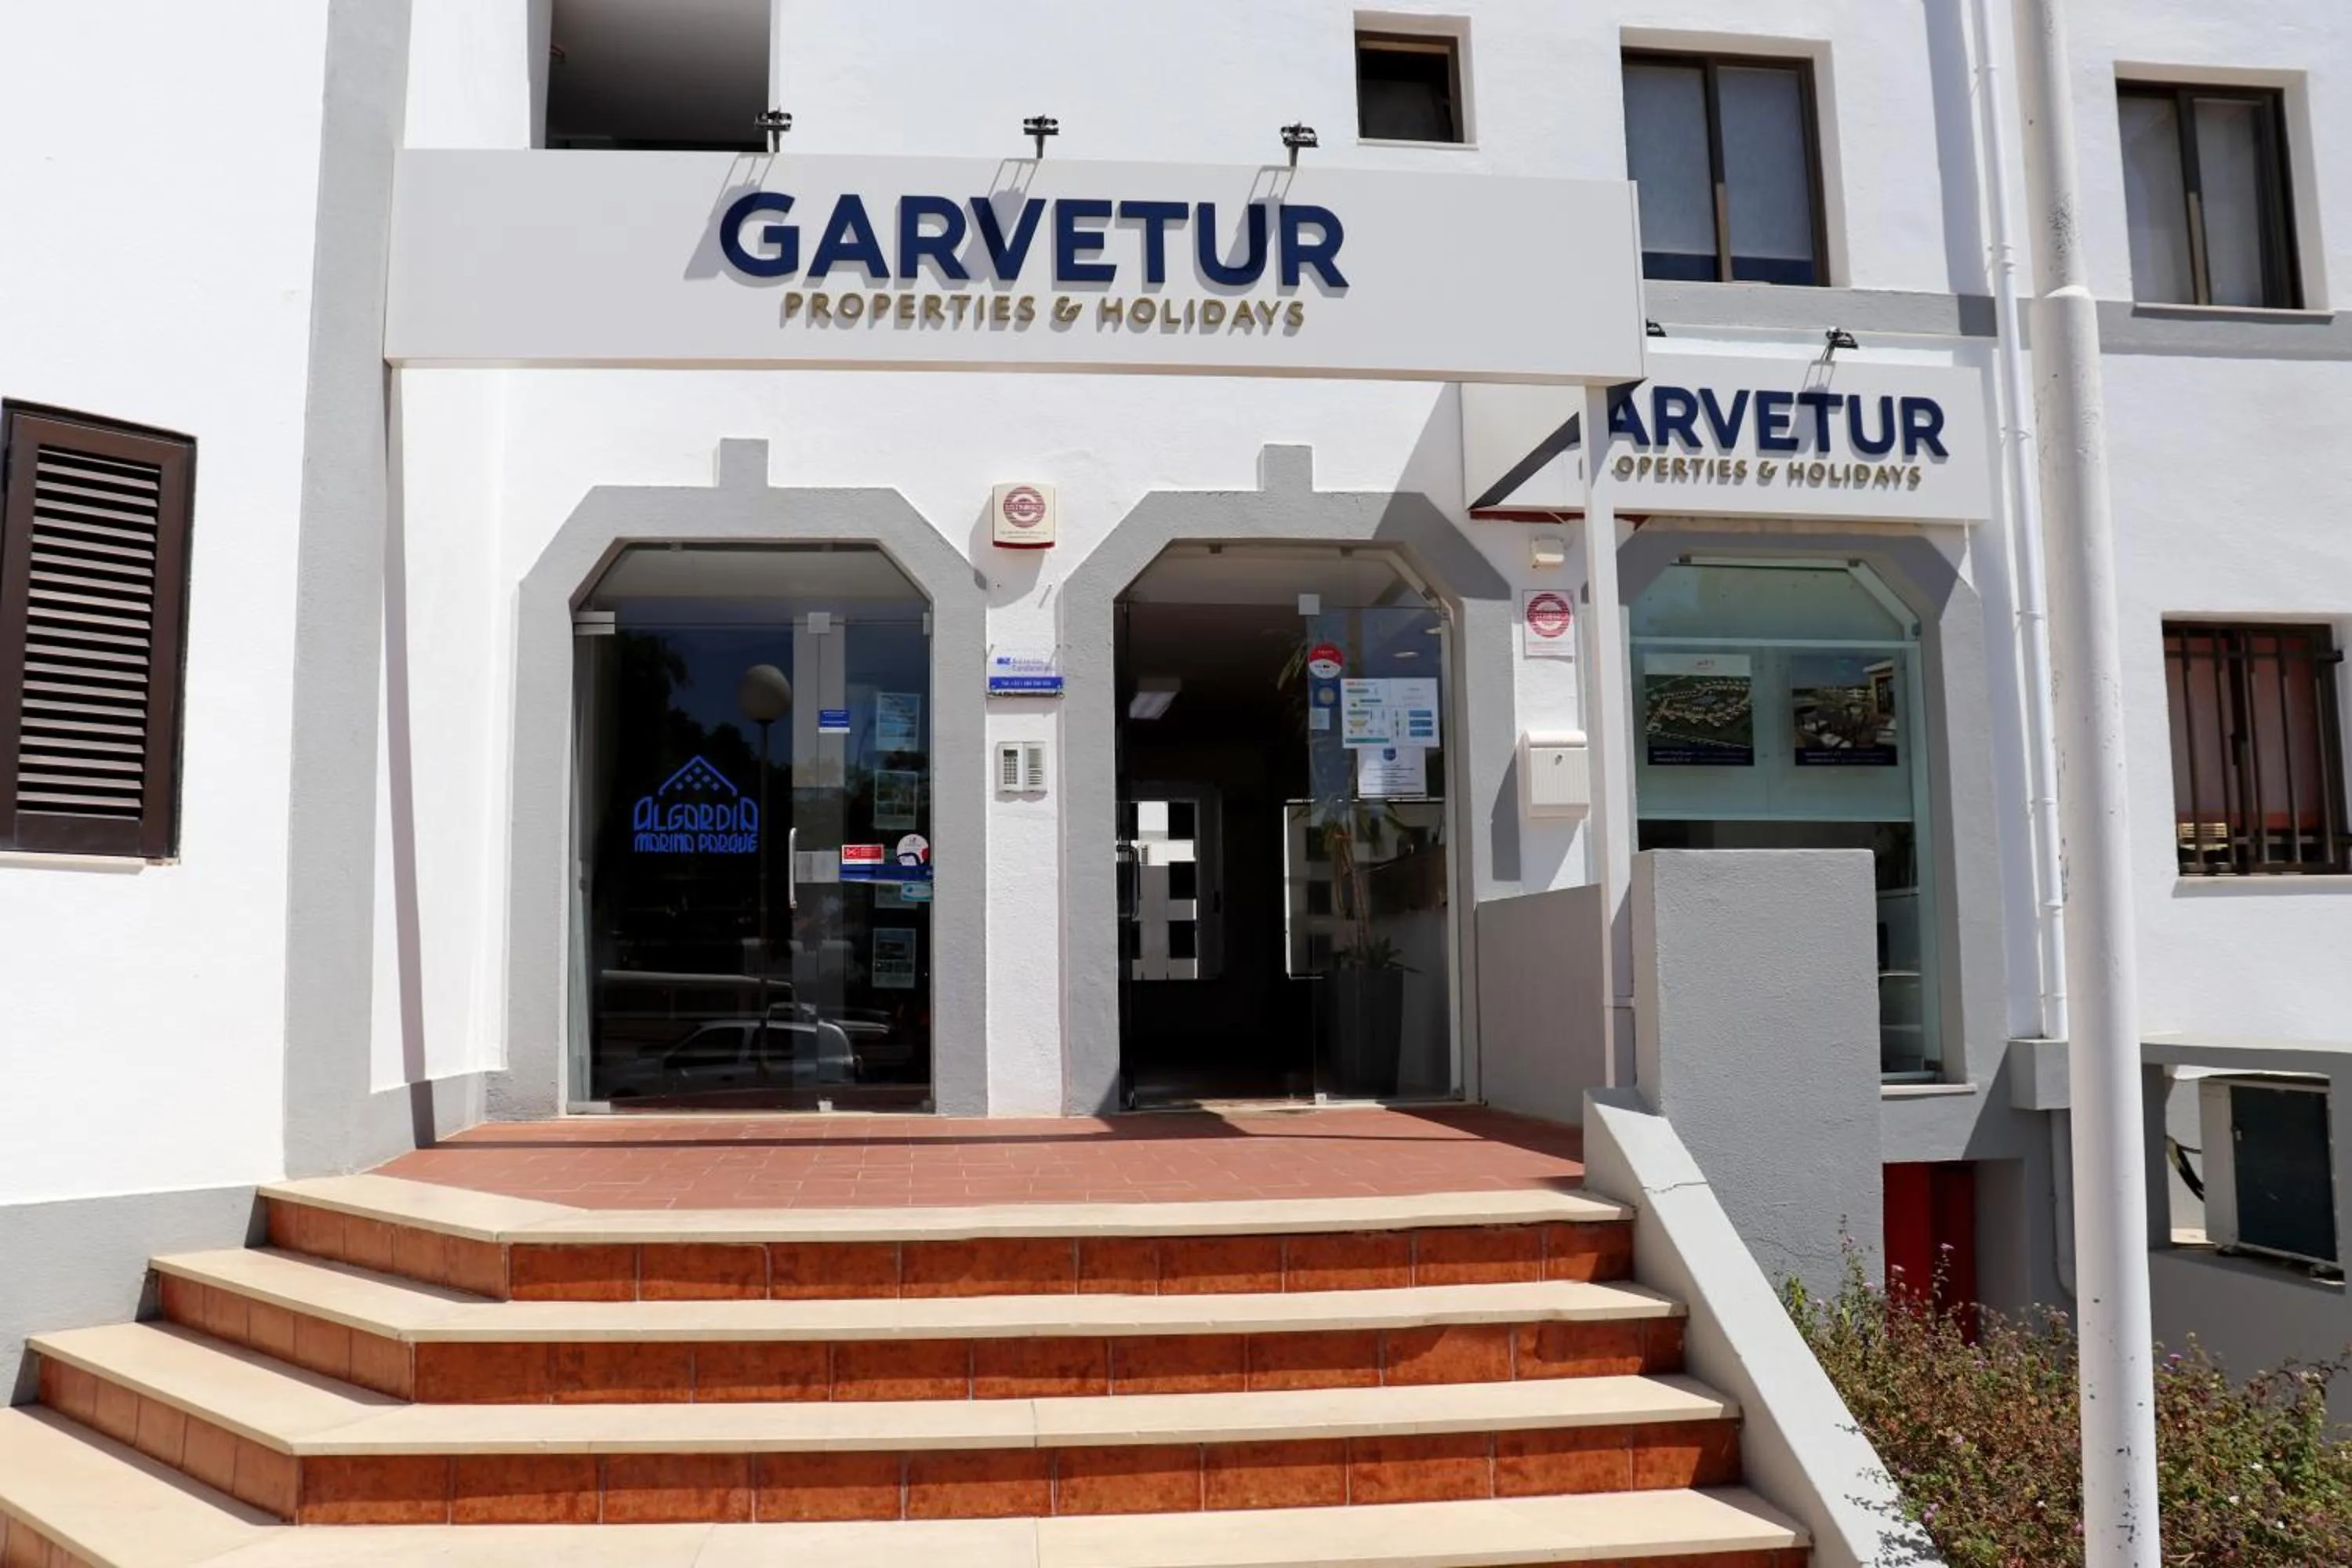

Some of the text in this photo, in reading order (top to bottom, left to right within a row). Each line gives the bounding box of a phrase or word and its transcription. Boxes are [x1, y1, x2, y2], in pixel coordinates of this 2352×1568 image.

[720, 192, 1349, 287] GARVETUR
[785, 292, 1305, 327] PROPERTIES & HOLIDAYS
[1609, 386, 1948, 457] ARVETUR
[1613, 455, 1922, 485] OPERTIES & HOLIDAYS
[633, 796, 759, 832] ALGARDIA
[634, 832, 758, 854] MARINA PARQUE
